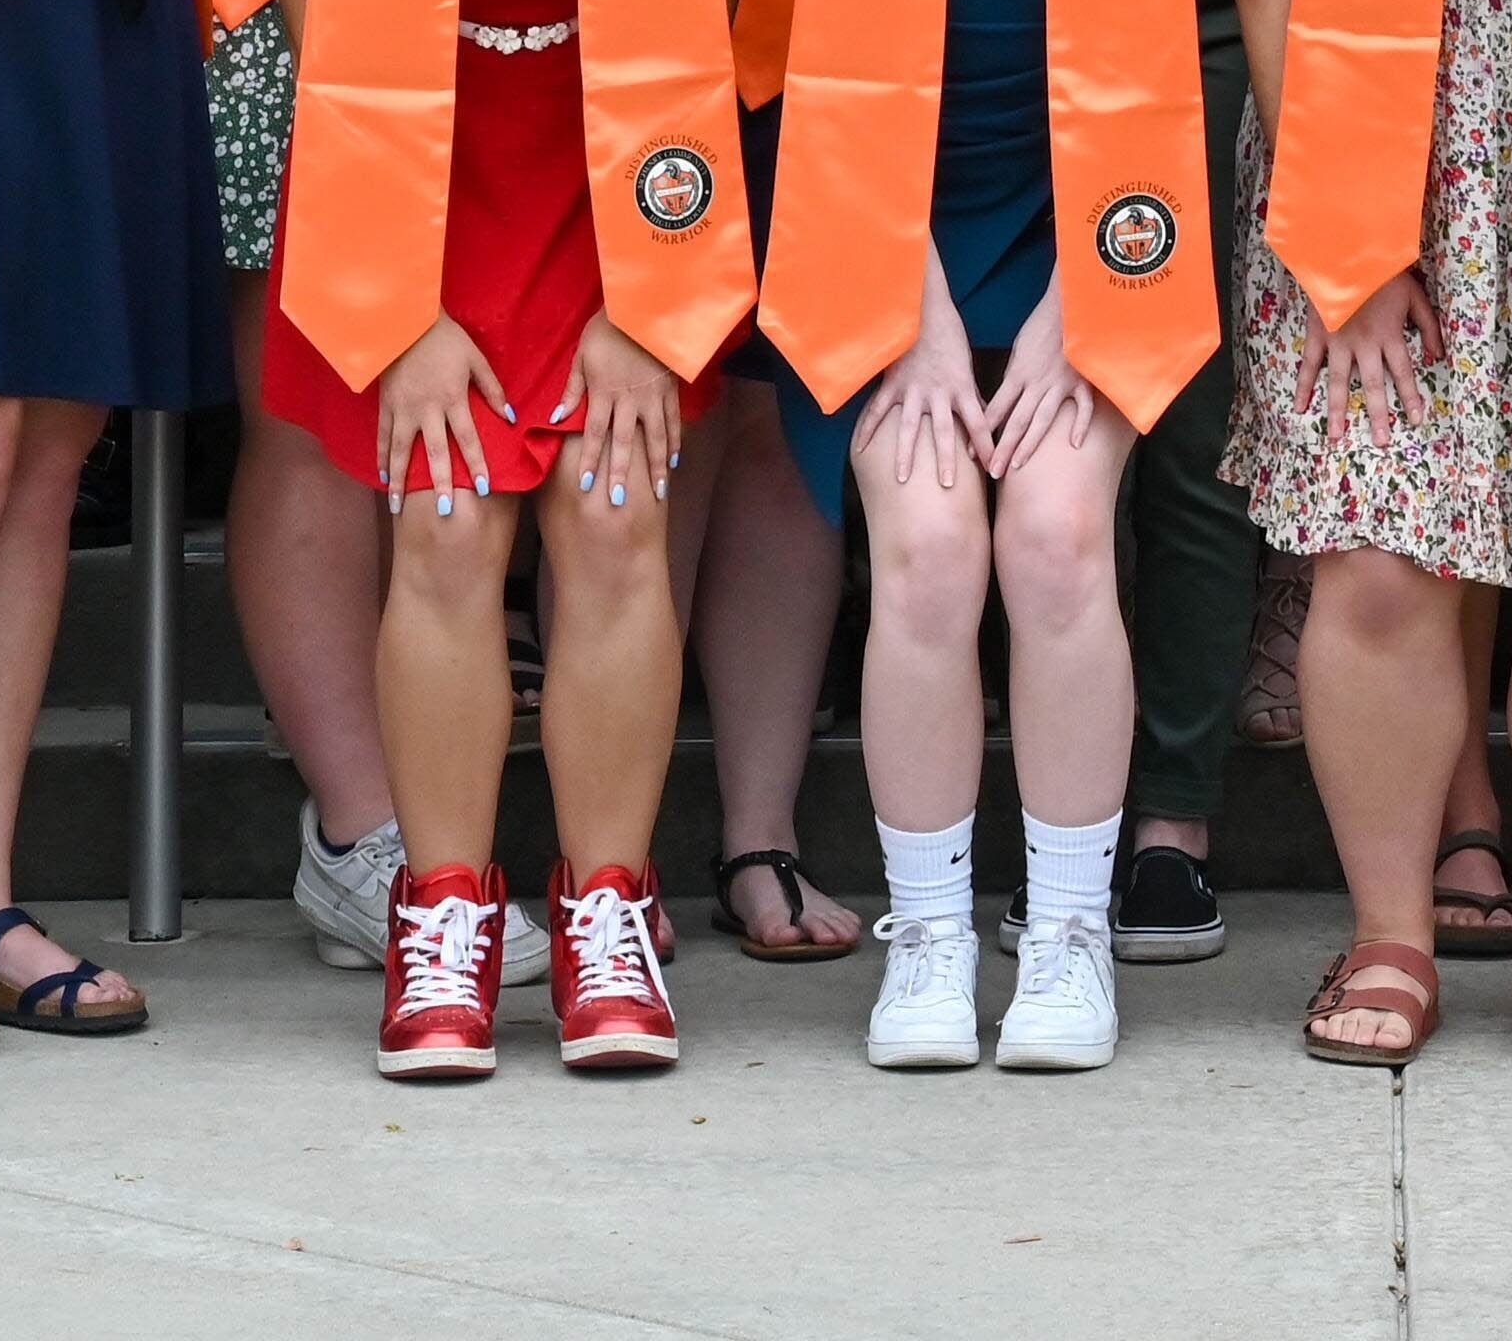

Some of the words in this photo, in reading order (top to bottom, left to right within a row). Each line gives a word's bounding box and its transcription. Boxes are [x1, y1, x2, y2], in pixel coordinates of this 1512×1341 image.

[625, 134, 718, 181] DISTINGUISHED
[1086, 180, 1182, 226] DISTINGUISHED
[651, 217, 712, 245] WARRIOR
[1108, 266, 1173, 290] WARRIOR
